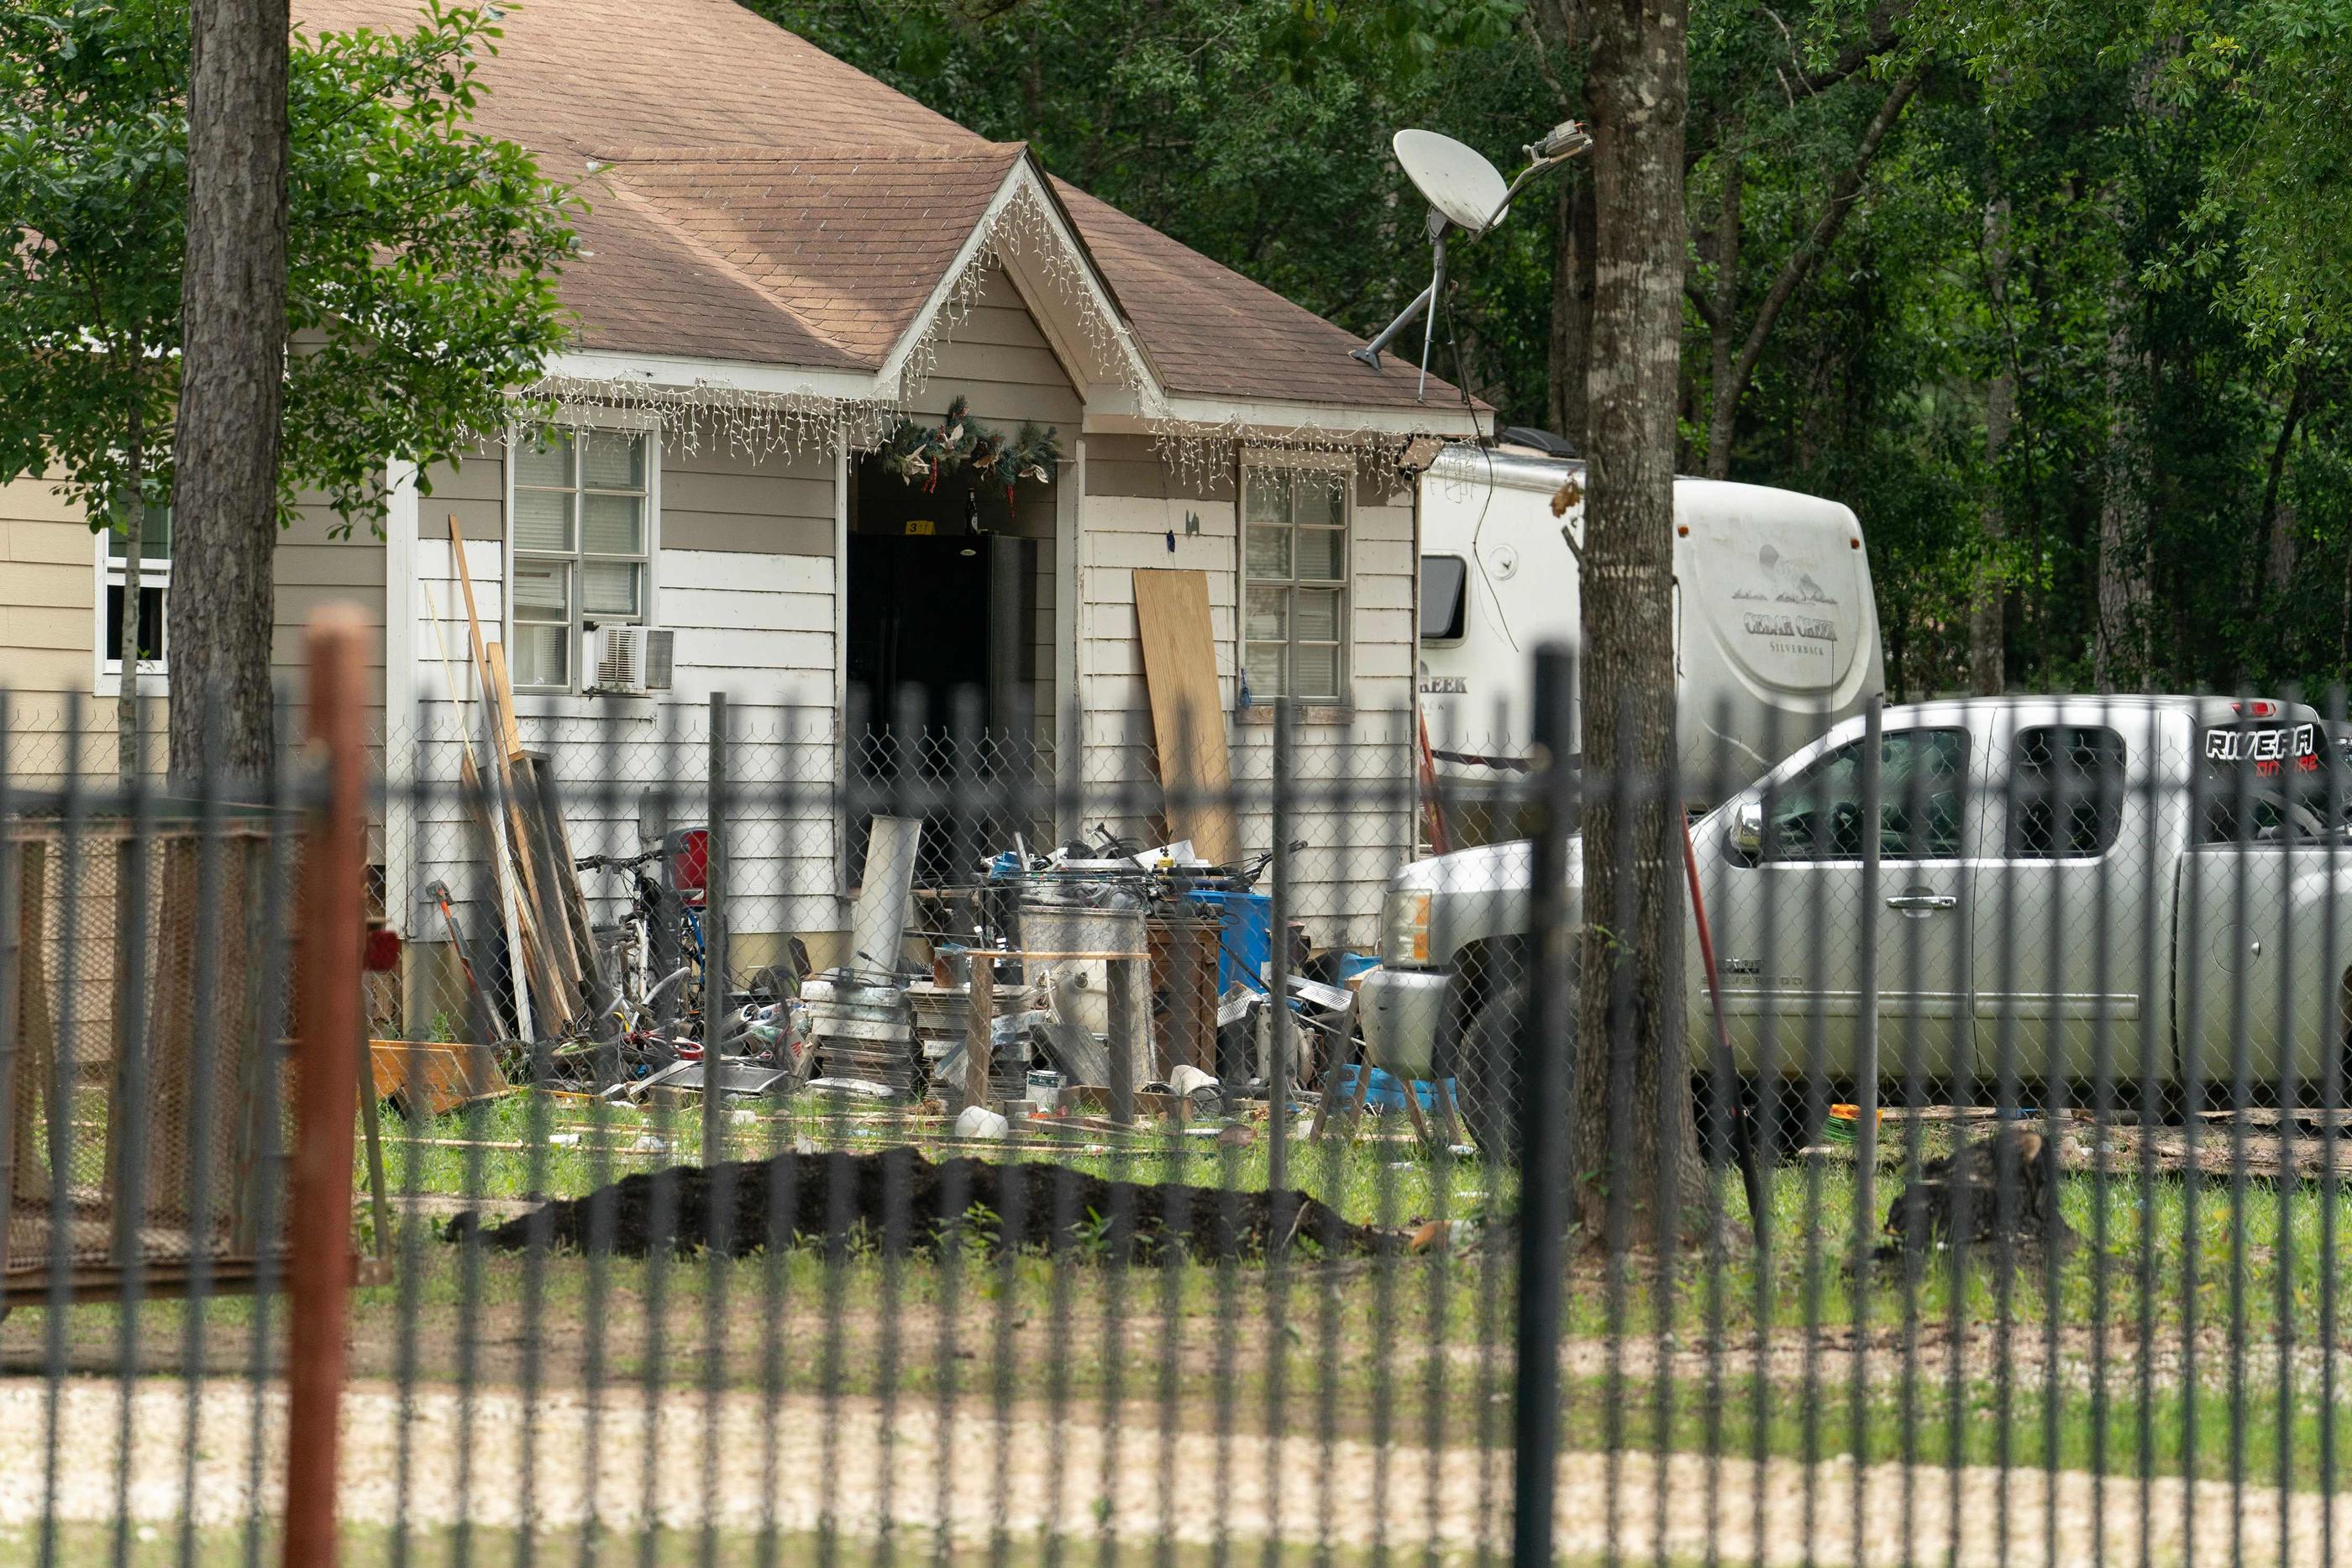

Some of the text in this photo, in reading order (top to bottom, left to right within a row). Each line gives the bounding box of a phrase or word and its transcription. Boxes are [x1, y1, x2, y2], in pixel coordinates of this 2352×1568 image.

[1744, 611, 1838, 642] CEDAR CREEK
[1771, 642, 1824, 655] SILVERBACK
[2207, 725, 2313, 760] RIVERA
